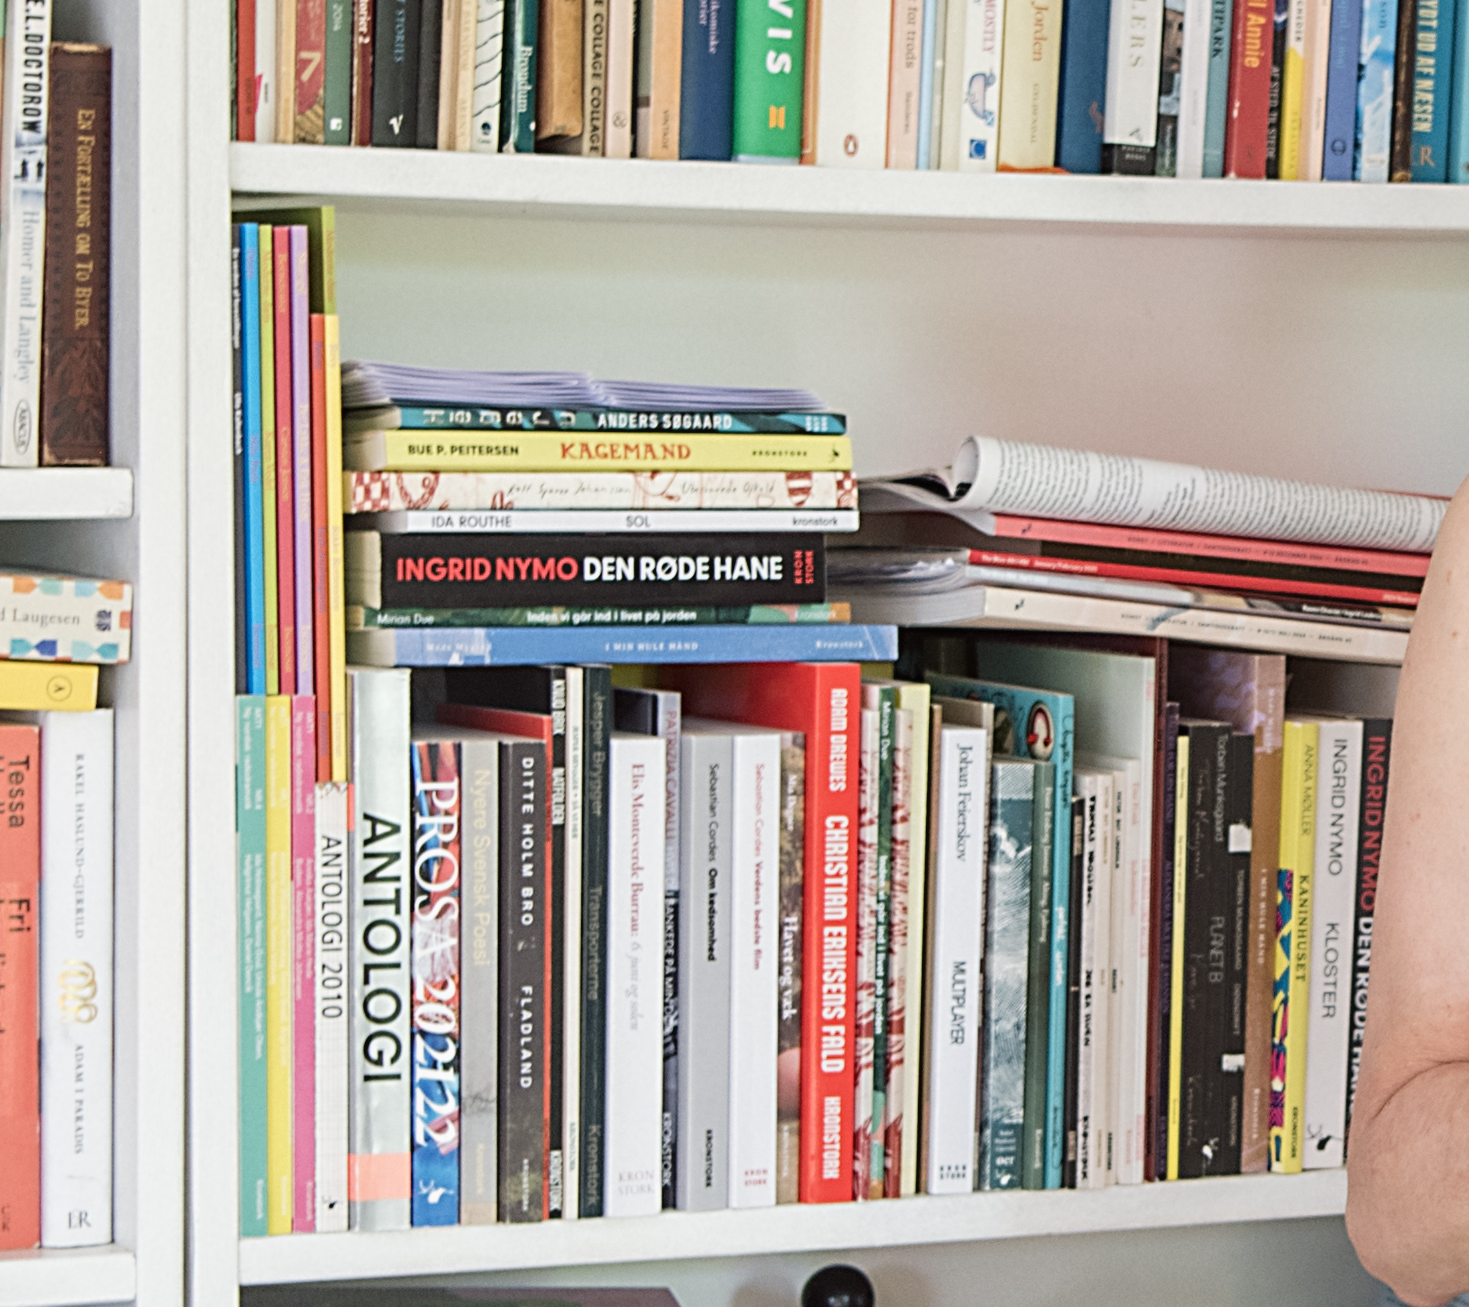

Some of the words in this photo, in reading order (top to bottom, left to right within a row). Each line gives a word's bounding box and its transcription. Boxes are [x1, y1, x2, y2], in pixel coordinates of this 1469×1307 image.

[561, 443, 691, 460] KAGEMAND
[396, 558, 491, 582] INGRID
[495, 557, 579, 581] NYMO
[583, 557, 636, 582] DEN
[640, 557, 709, 582] RØDE
[714, 557, 782, 581] HANE
[10, 609, 81, 627] Laugesen
[6, 755, 30, 828] Tessa
[8, 898, 30, 934] Fri
[321, 835, 342, 951] ANTOLOGI
[362, 812, 402, 1084] ANTOLOGI
[1322, 923, 1338, 1020] KLOSTER
[321, 962, 342, 1019] 2010
